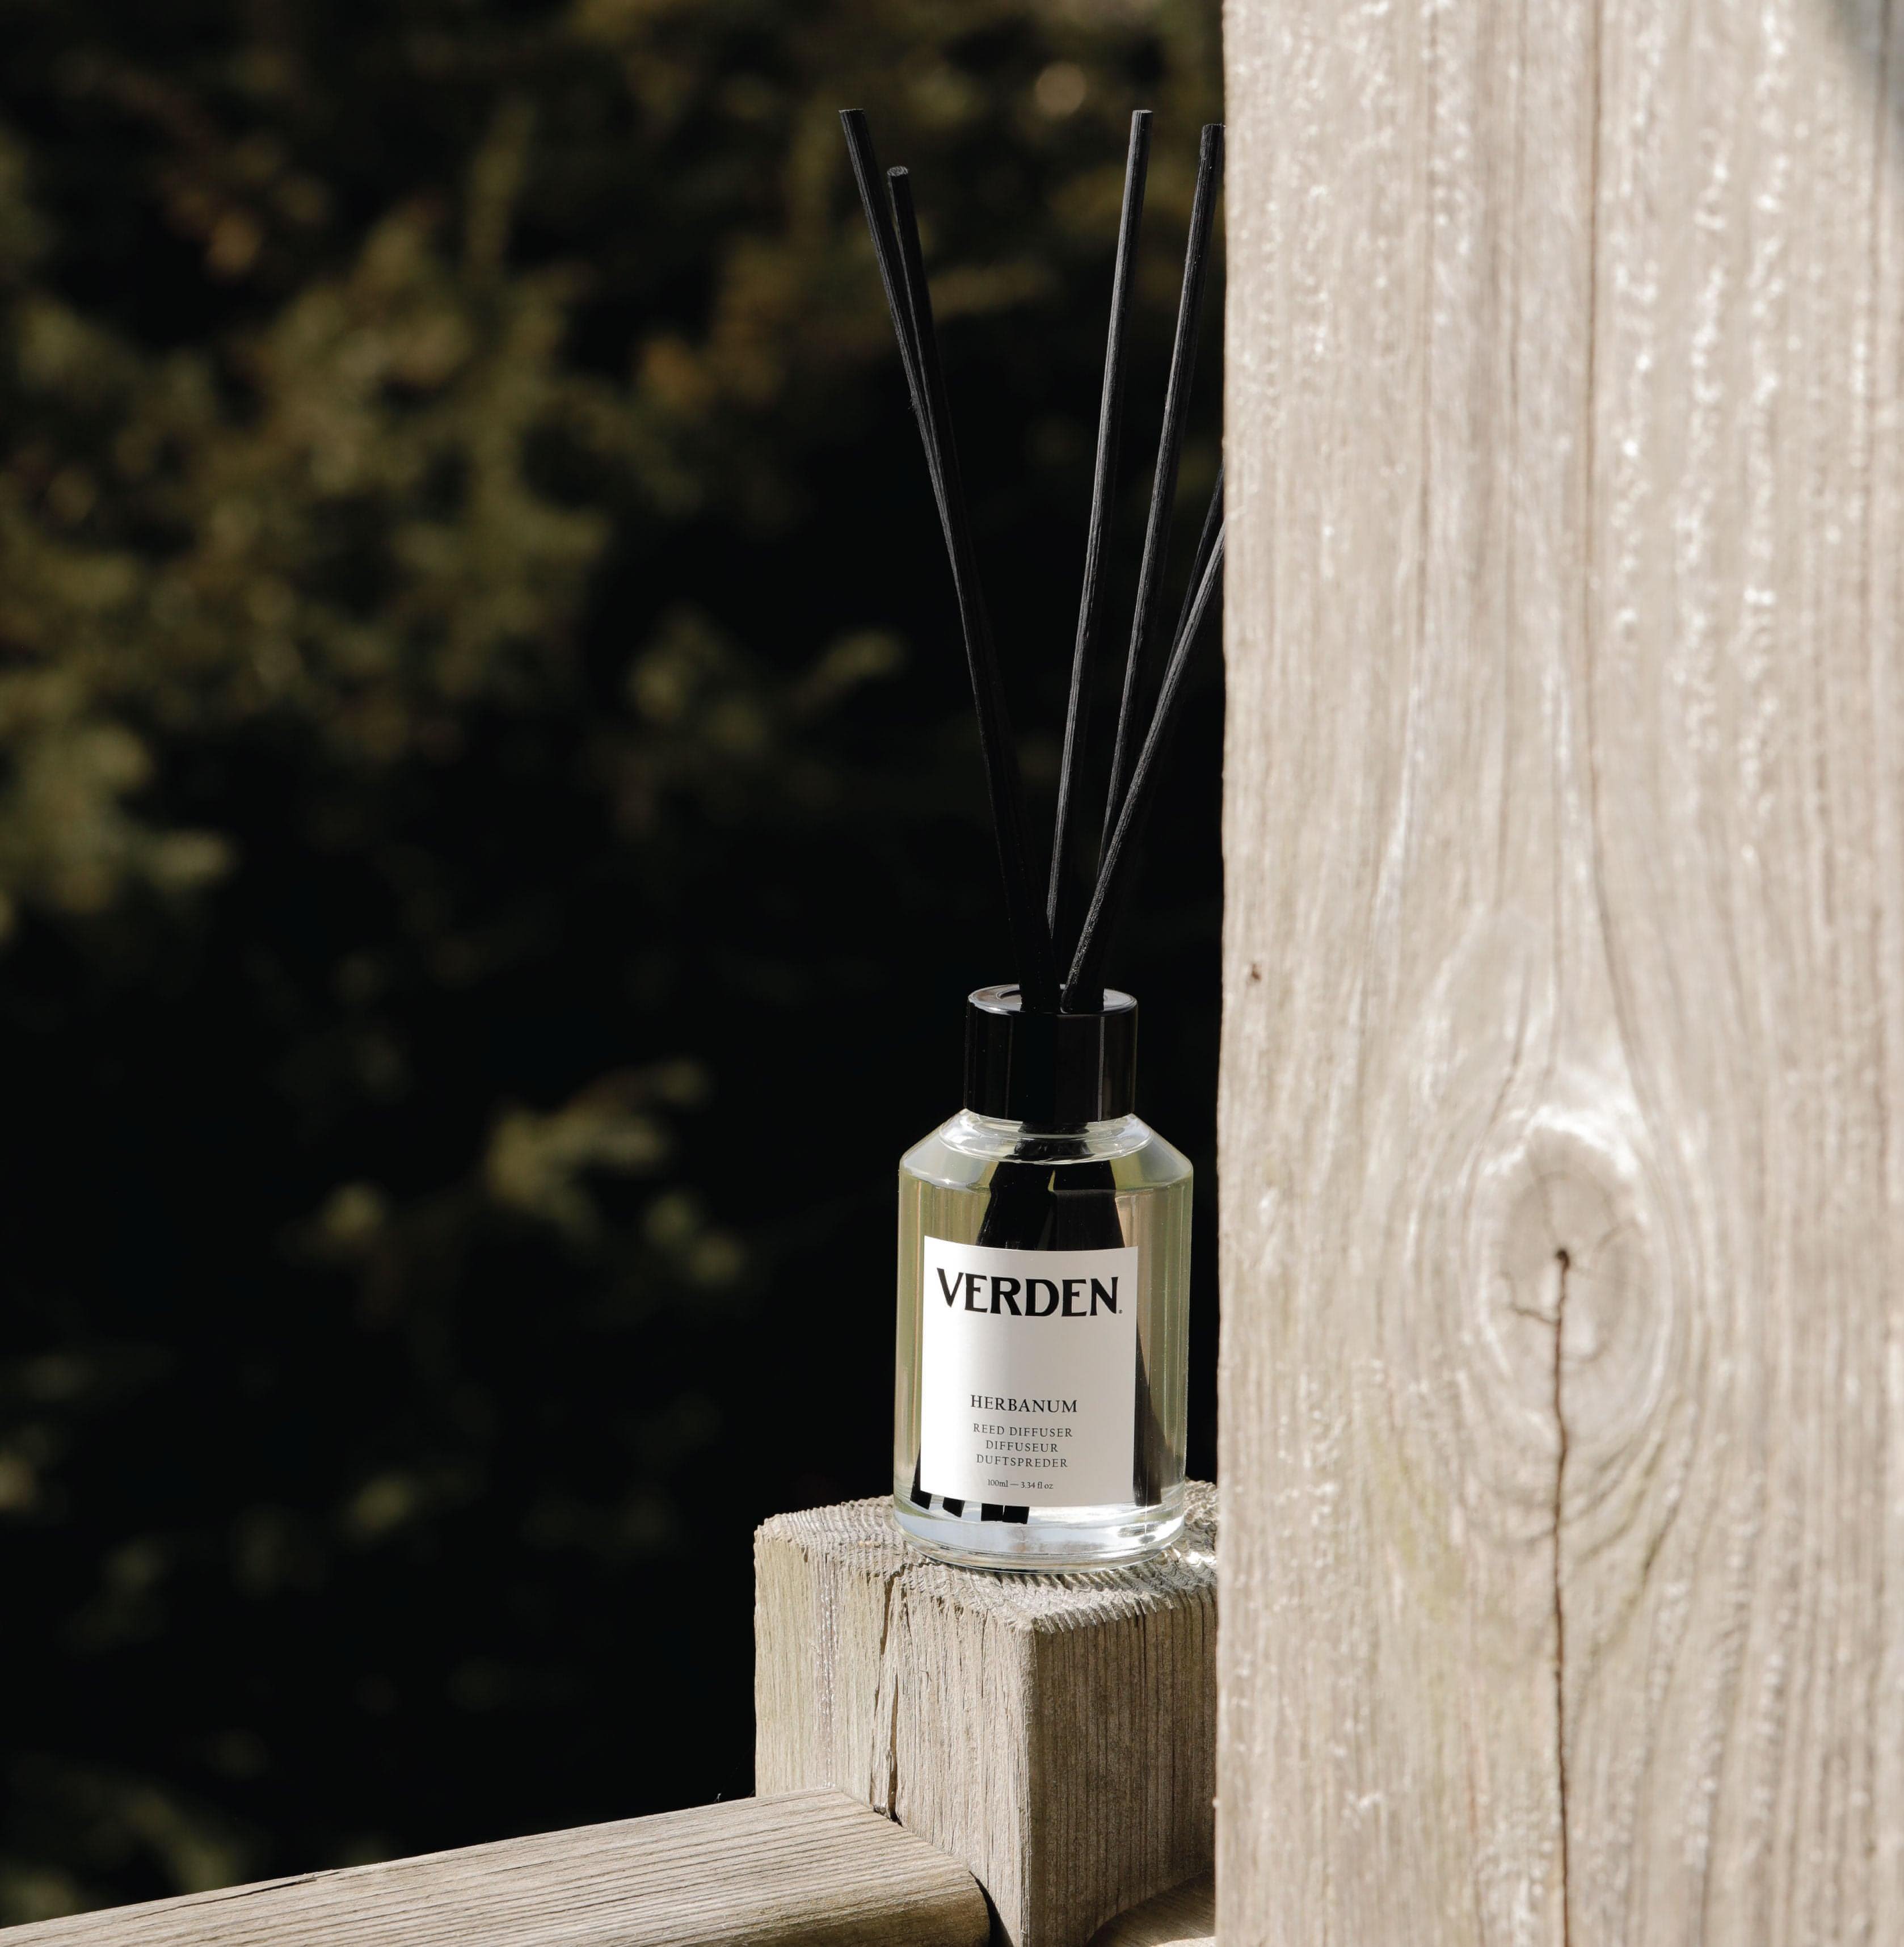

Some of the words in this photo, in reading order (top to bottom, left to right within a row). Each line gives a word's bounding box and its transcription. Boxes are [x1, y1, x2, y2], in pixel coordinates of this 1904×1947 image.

[970, 1394, 1077, 1412] HERBANUM
[973, 1423, 1004, 1435] REED
[1009, 1427, 1072, 1437] DIFFUSER
[985, 1440, 1058, 1452] DIFFUSEUR
[976, 1454, 1068, 1467] DUFTSPREDER
[987, 1479, 1008, 1487] 100ml
